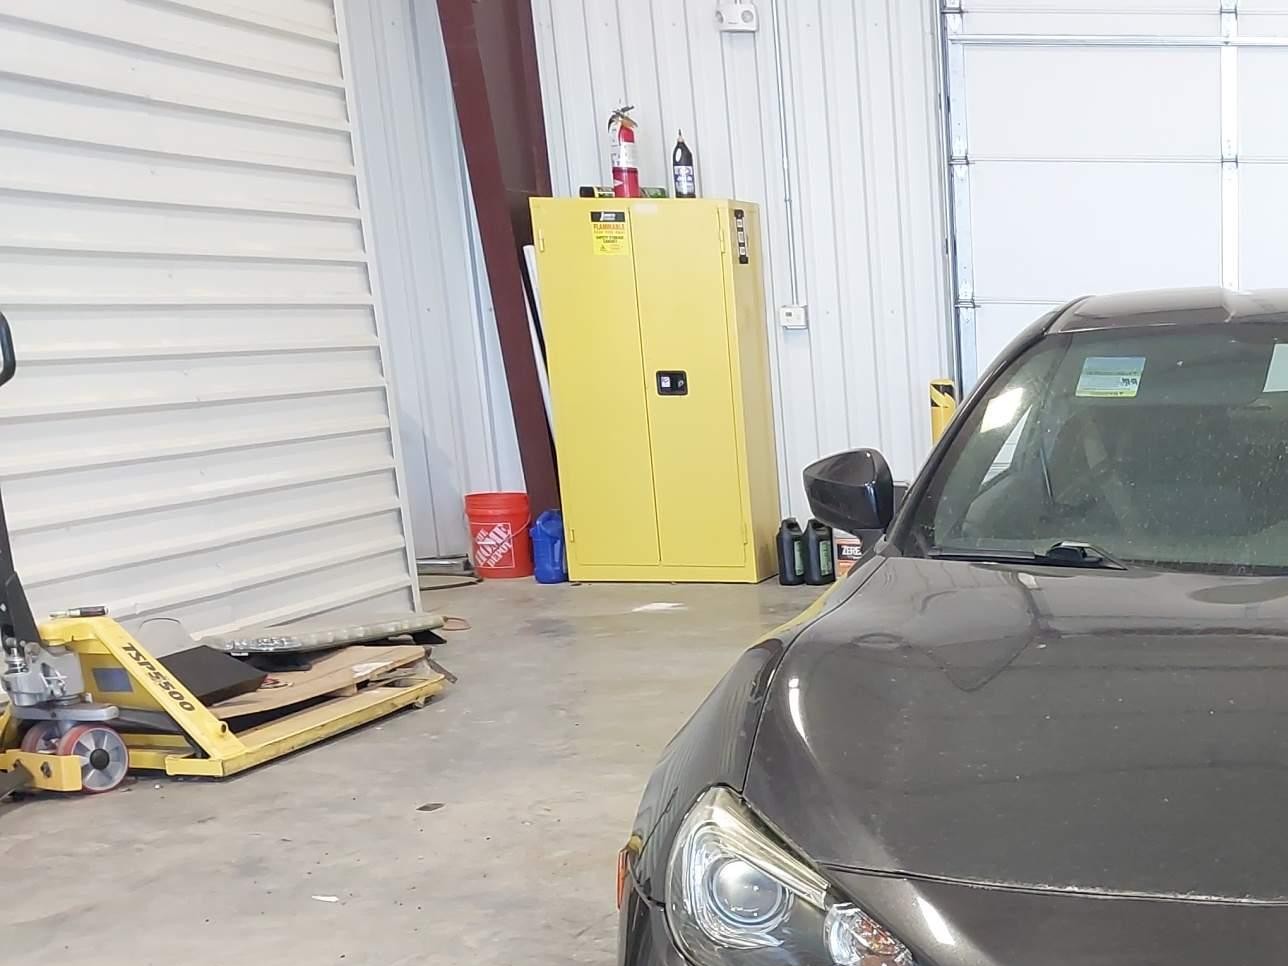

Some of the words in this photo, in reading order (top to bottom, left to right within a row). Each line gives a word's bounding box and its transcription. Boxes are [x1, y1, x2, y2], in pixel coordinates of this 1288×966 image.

[475, 523, 511, 567] HOME
[487, 541, 512, 568] DEPOT
[840, 545, 862, 556] ZERE
[121, 642, 195, 711] TSP5500
